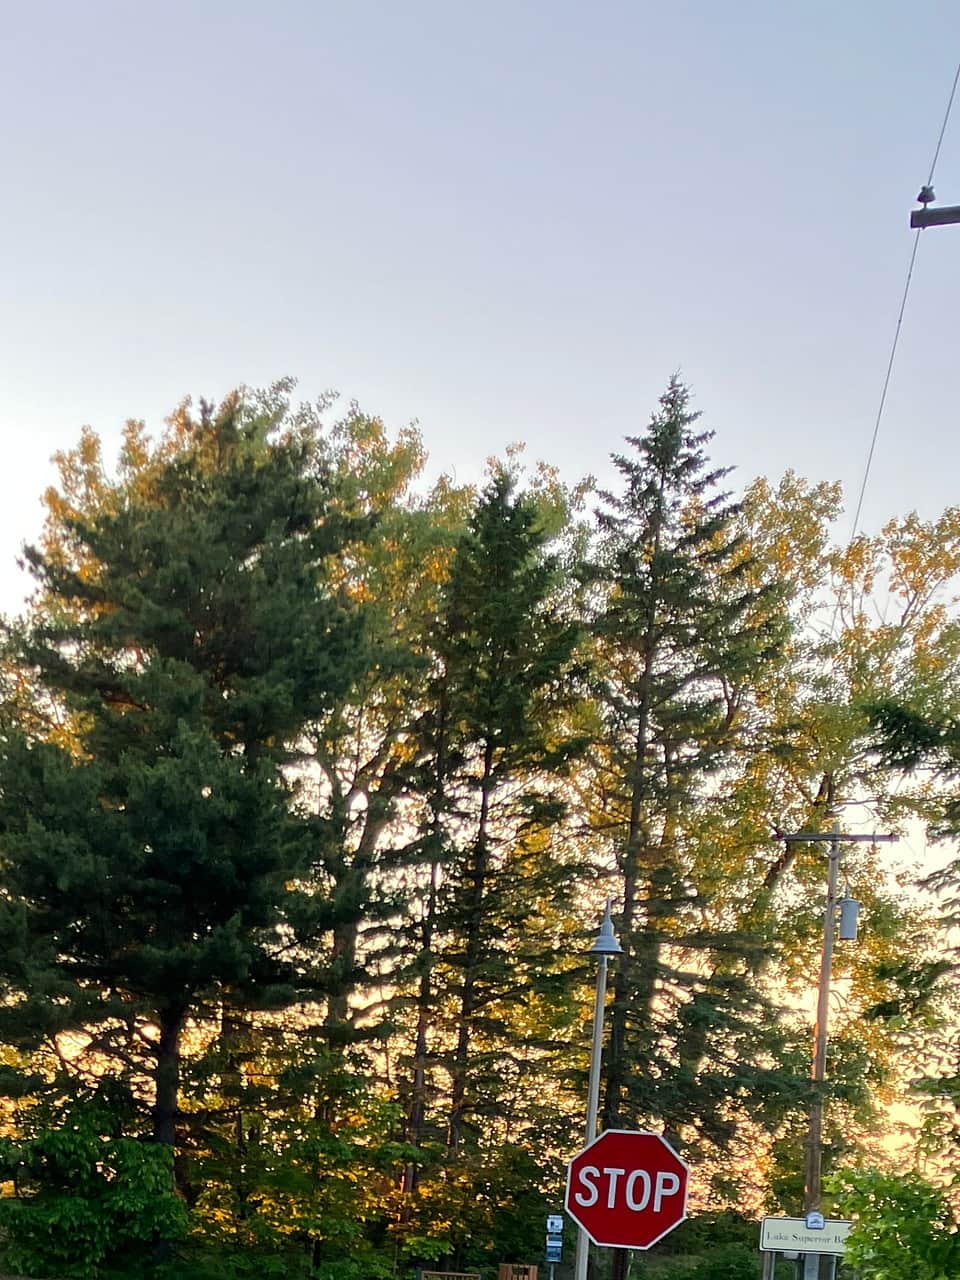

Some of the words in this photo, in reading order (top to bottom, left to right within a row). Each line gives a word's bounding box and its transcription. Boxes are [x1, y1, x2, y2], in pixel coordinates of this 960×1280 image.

[575, 1165, 680, 1212] STOP
[767, 1232, 788, 1241] Lake
[791, 1233, 831, 1244] Superior
